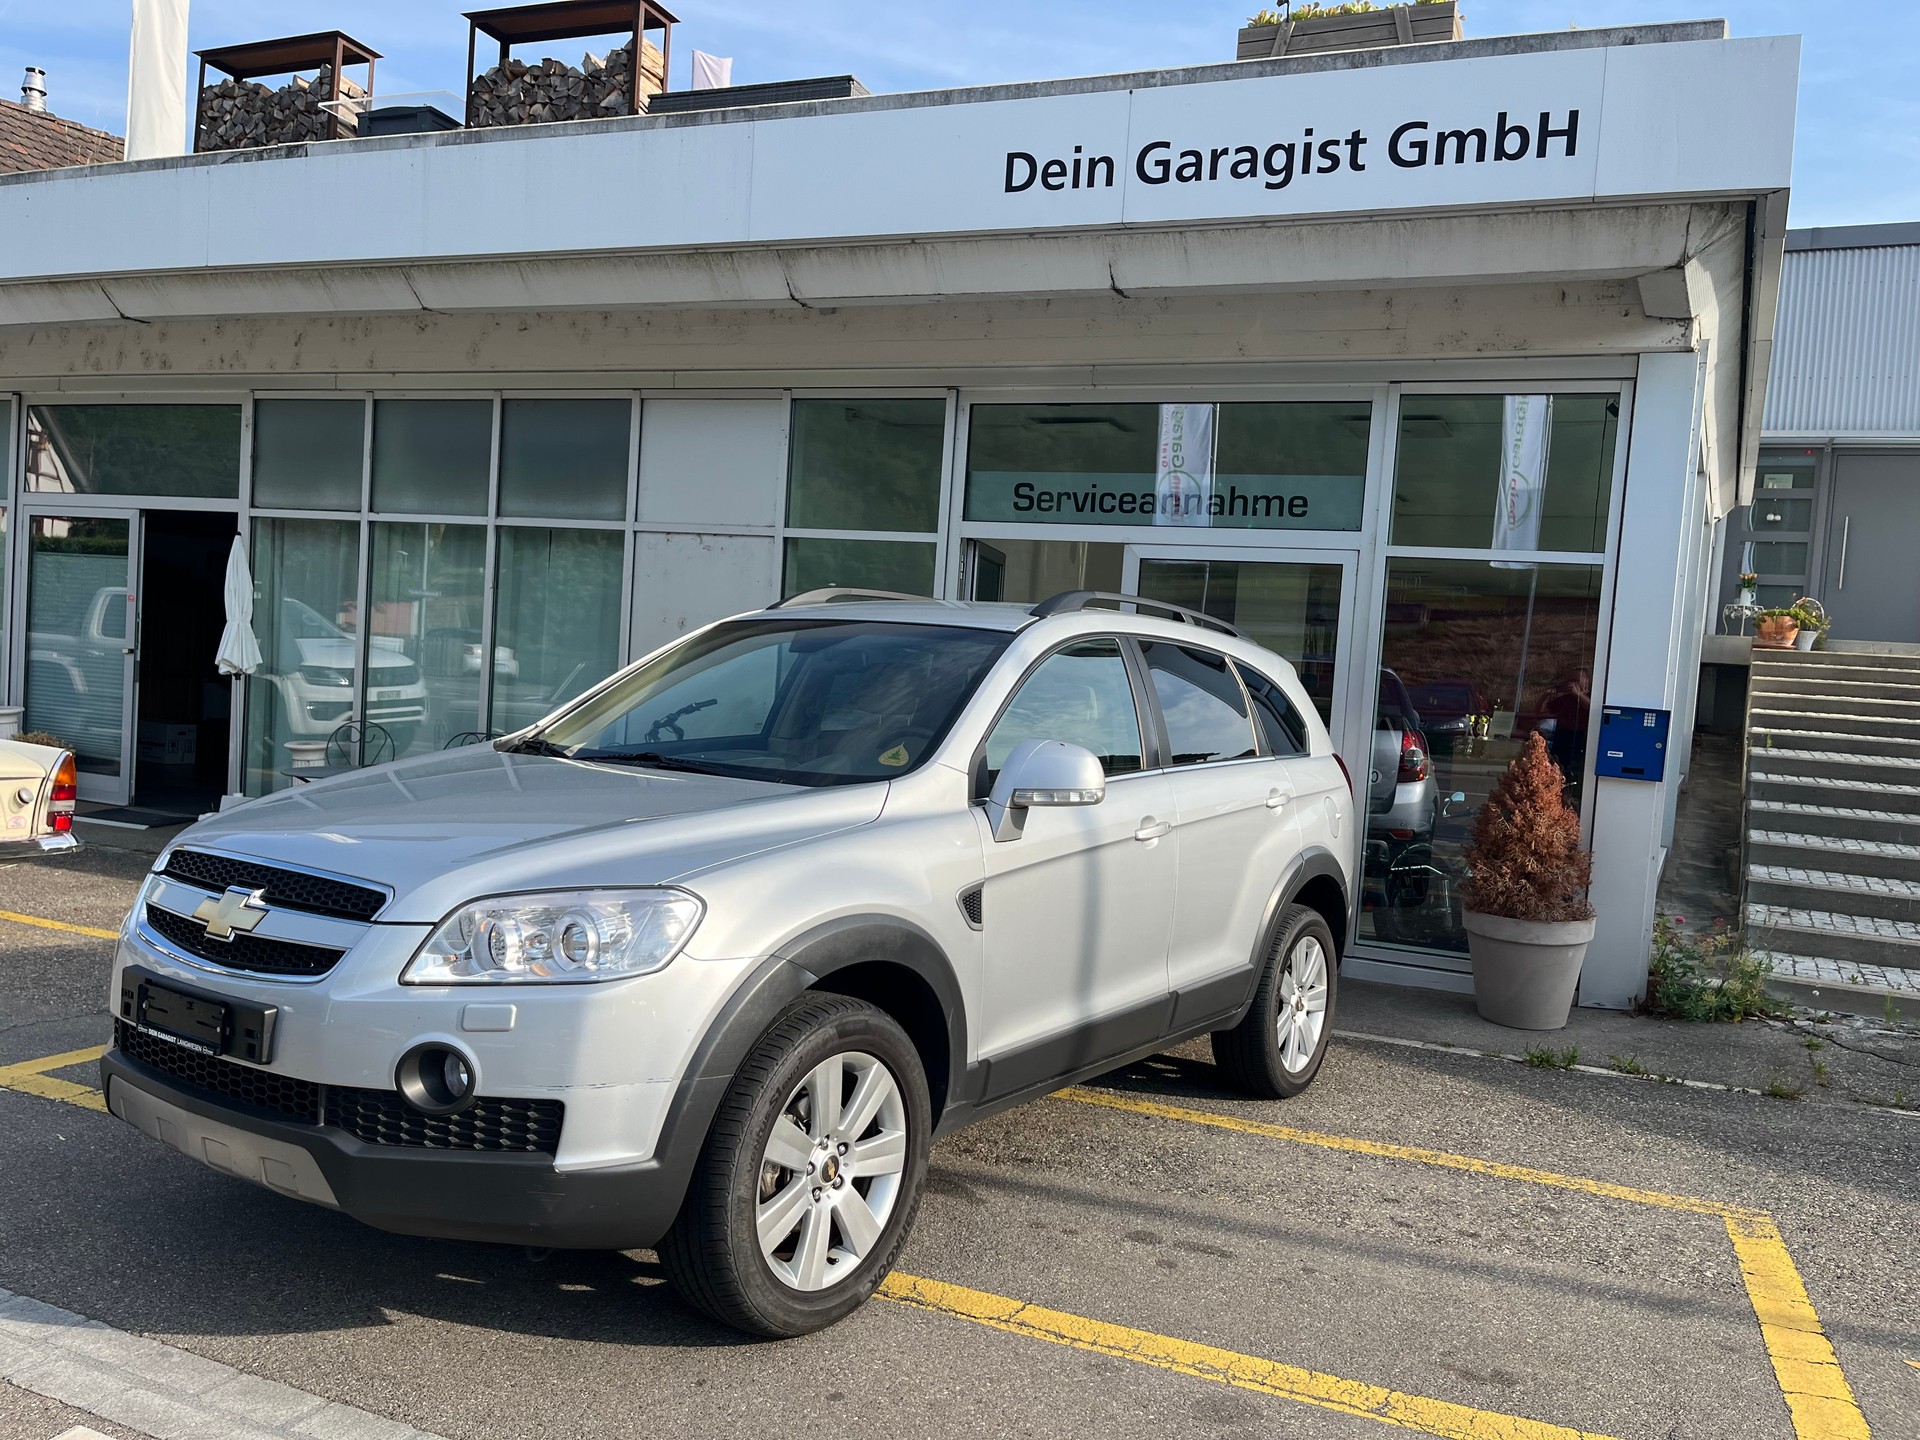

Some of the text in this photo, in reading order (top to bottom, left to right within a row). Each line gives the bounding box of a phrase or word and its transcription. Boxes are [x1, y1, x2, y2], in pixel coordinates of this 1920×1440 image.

[1004, 109, 1580, 193] Dein Garagist GmbH
[1012, 483, 1309, 518] Serviceannahme
